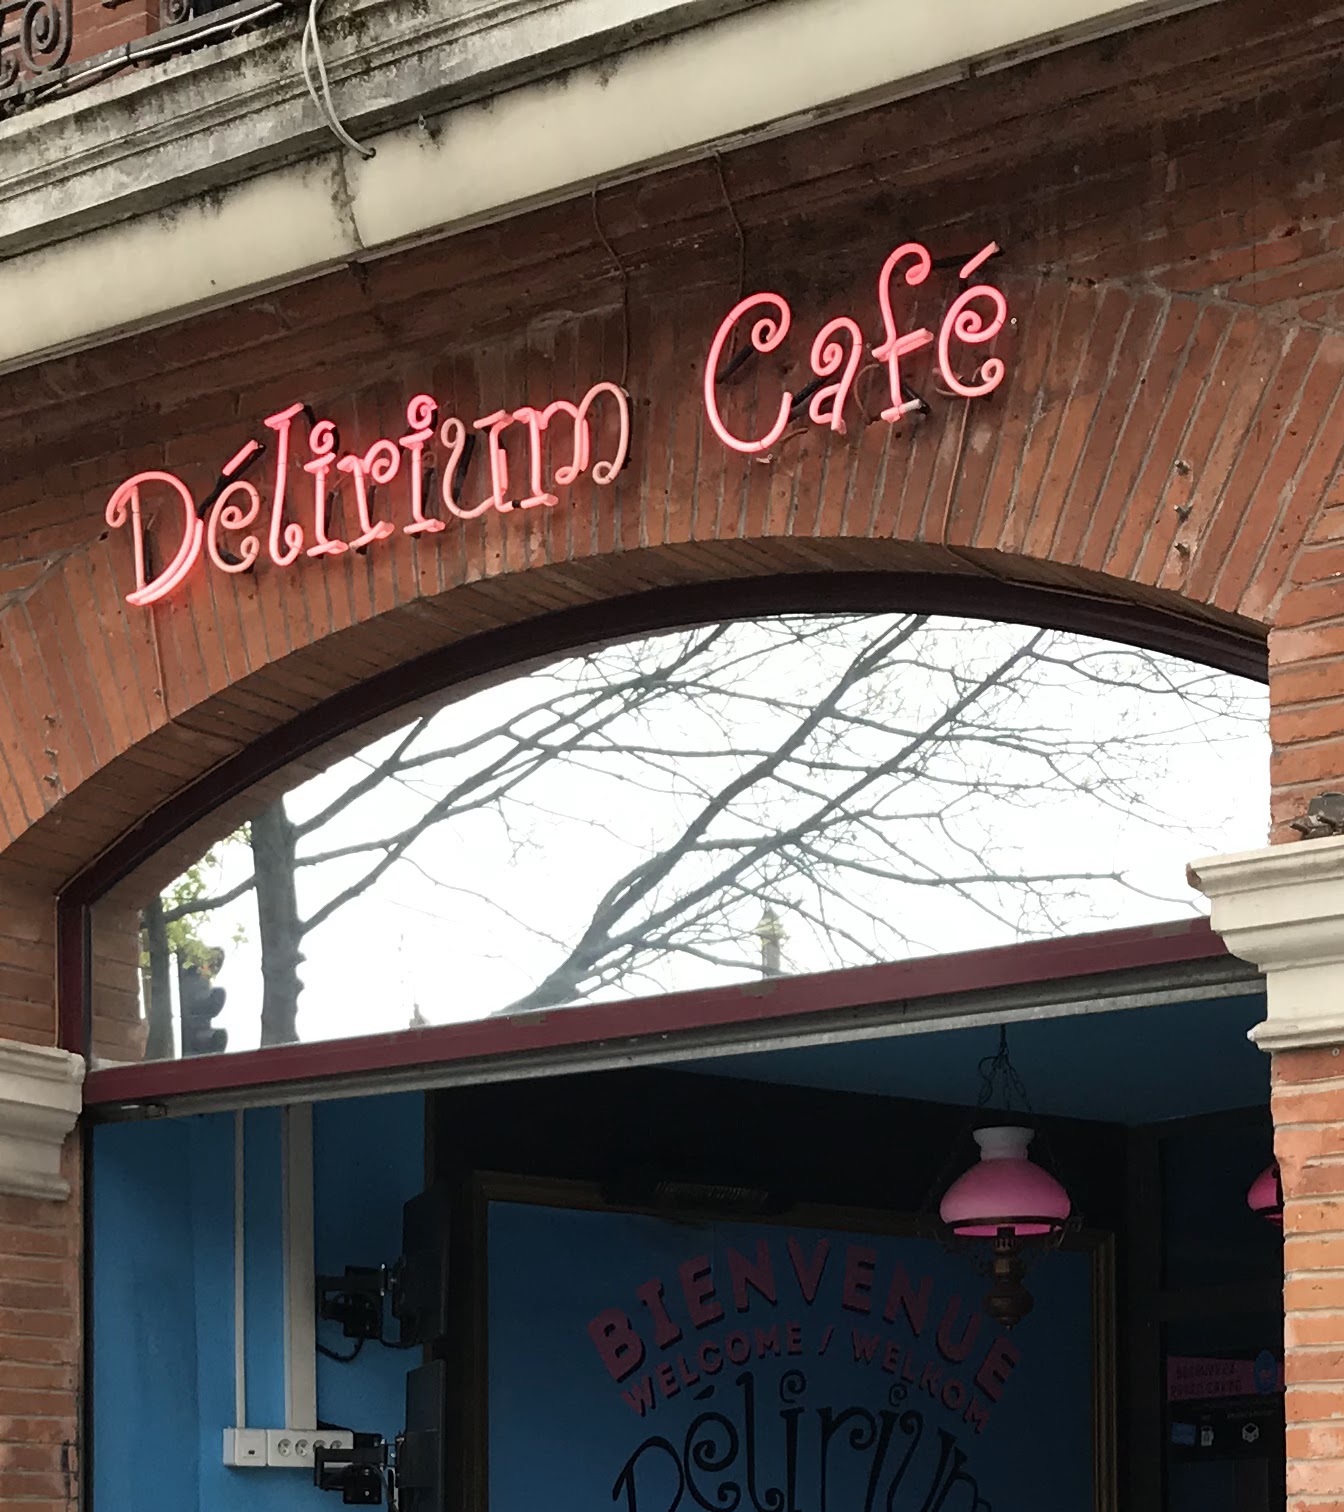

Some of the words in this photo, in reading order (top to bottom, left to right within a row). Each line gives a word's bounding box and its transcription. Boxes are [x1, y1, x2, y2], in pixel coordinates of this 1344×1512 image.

[105, 382, 629, 606] Délirium
[704, 241, 1008, 453] Café
[587, 1235, 1022, 1403] BIENVENUE
[620, 1321, 805, 1417] WELCOME
[851, 1327, 995, 1434] WELKOM
